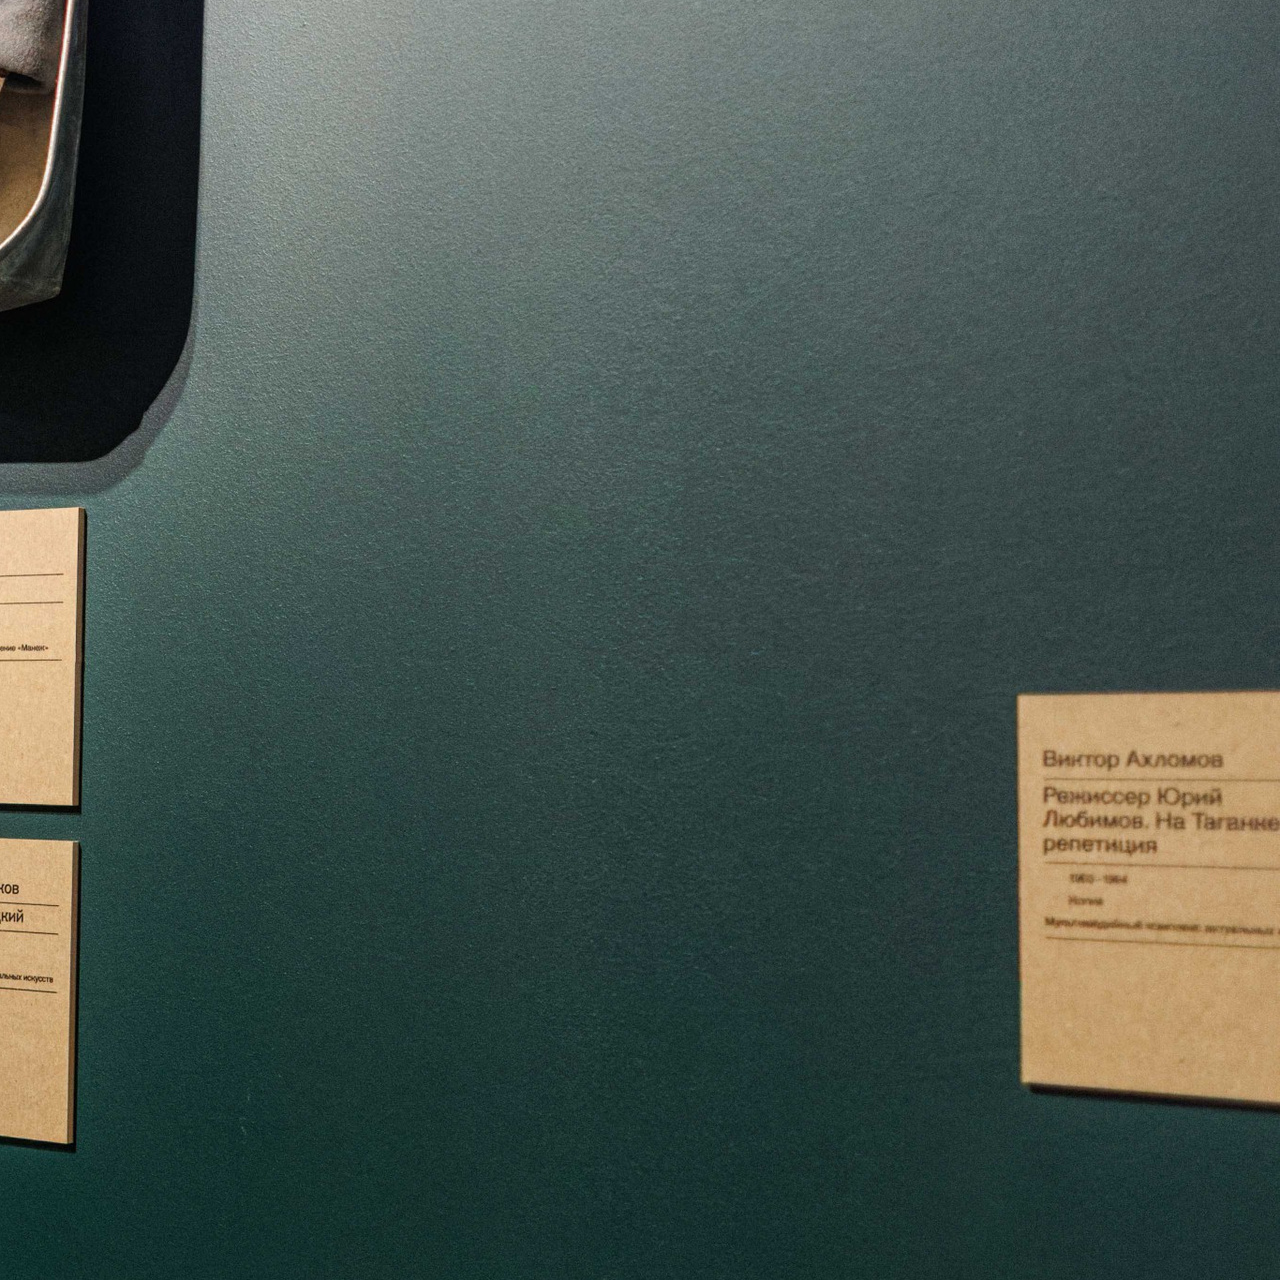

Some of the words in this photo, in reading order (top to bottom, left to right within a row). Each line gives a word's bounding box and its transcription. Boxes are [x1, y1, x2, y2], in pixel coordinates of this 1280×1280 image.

[1043, 750, 1120, 771] Виктор
[1127, 750, 1224, 768] Ахломов
[1043, 786, 1150, 808] Режиссер
[1157, 787, 1222, 808] Юрий
[1043, 810, 1149, 828] Любимов.
[1156, 812, 1186, 829] На
[1043, 838, 1158, 856] репетиция
[23, 975, 53, 984] искусств
